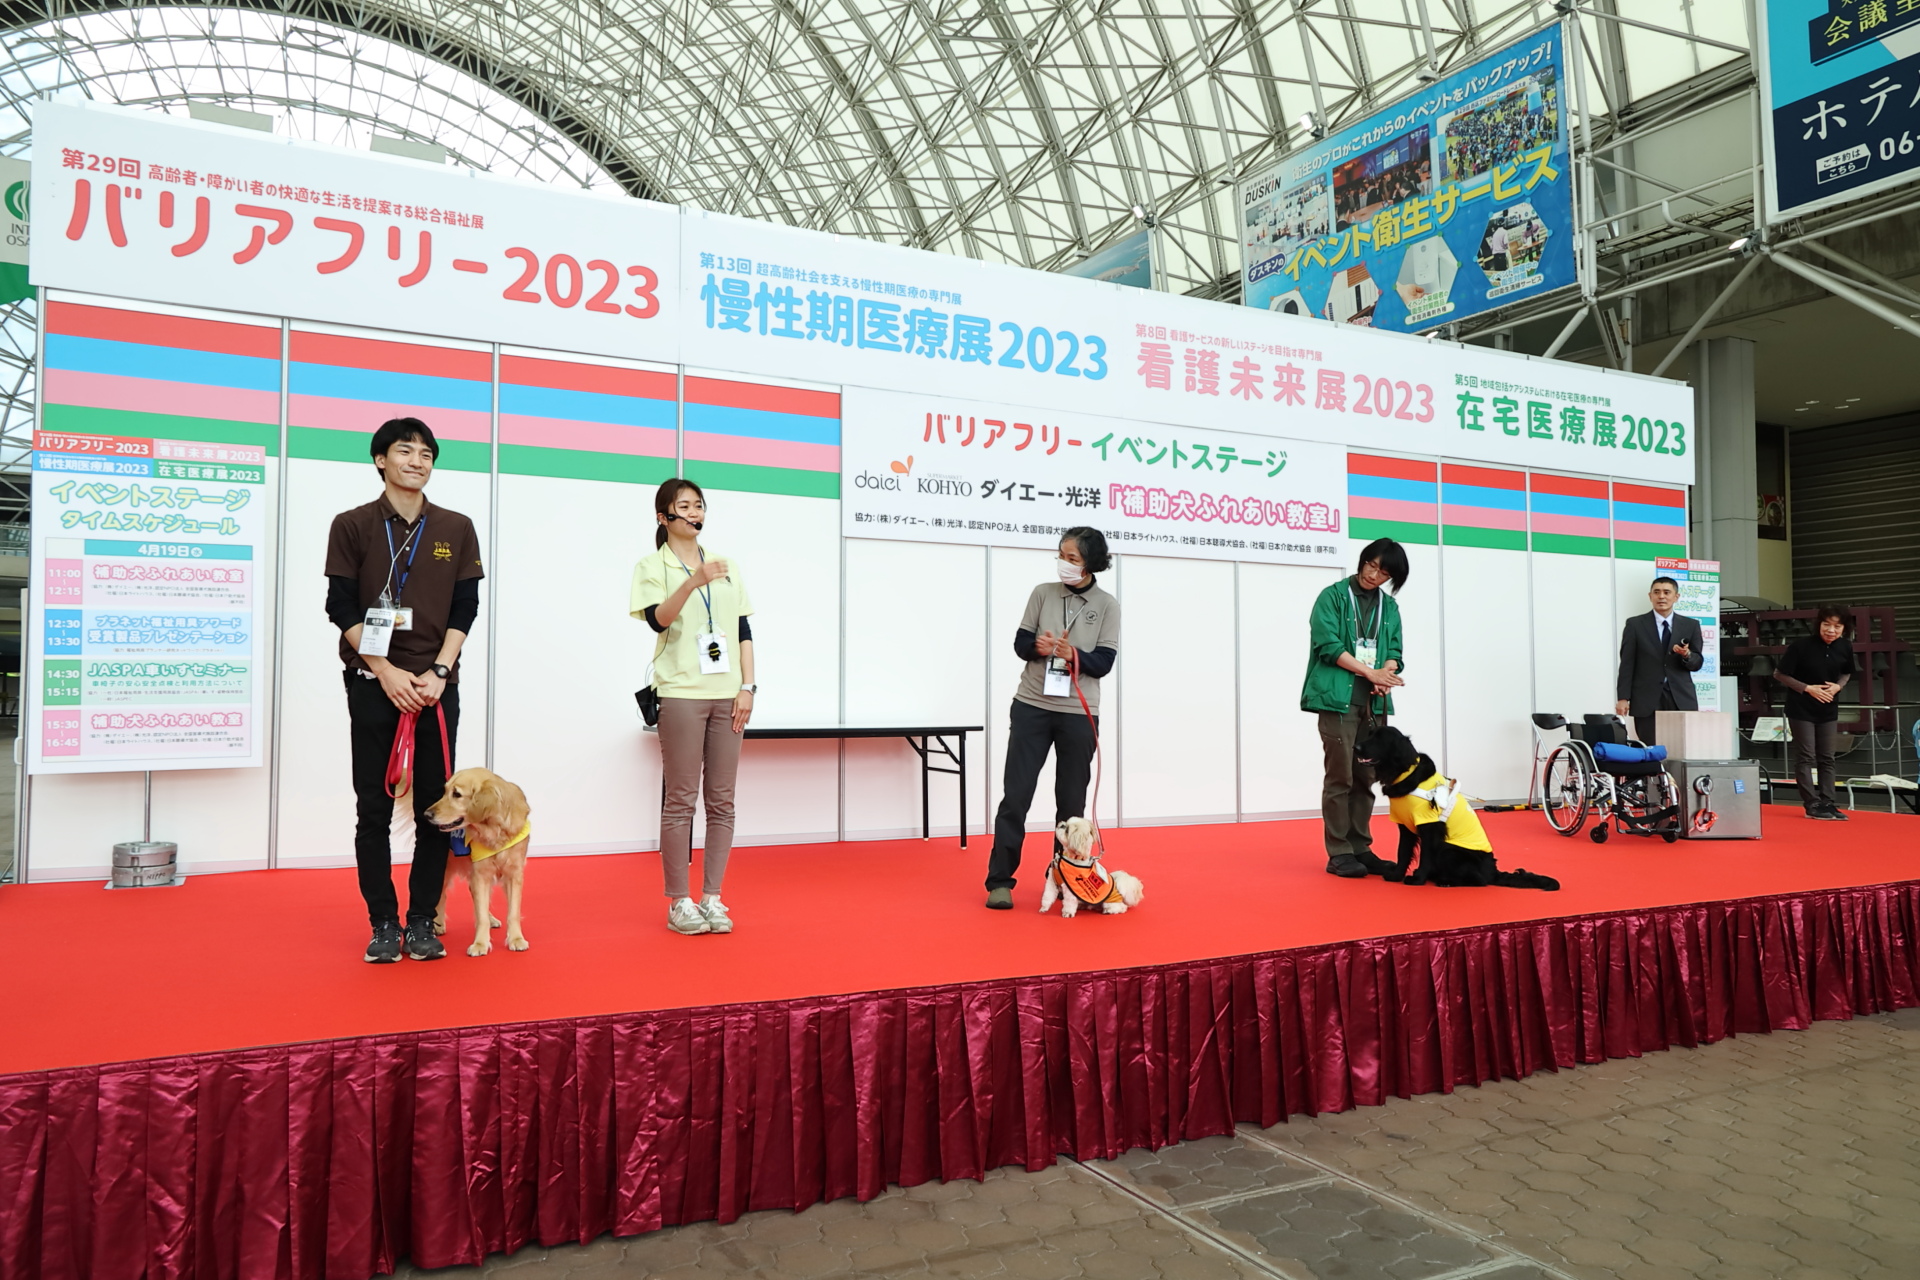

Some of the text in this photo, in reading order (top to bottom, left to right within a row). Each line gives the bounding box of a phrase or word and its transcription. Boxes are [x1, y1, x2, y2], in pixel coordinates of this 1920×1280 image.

[1823, 149, 1861, 168] ご予約は
[1829, 162, 1856, 178] こちら
[62, 148, 485, 230] 第29回 高齢者・障がい者の快適な生活を提案する総合福祉展
[1284, 146, 1559, 281] イベント衛生サービス
[699, 251, 963, 306] 第13回 超高齢社会を支える慢性期医療の専門展
[1250, 258, 1284, 281] ダスキンの
[699, 273, 1109, 381] 慢性期医療展2023
[1135, 323, 1323, 362] 第8回 看護サービスの新しいステージを目指す専門展
[1137, 341, 1435, 424] 看護未来展2023
[1455, 373, 1612, 408] 第5回 地域包括ケアシステムにおける在宅医療の専門展
[1456, 390, 1686, 457] 在宅医療展2023
[38, 436, 150, 455] バリアフリー2023
[158, 445, 261, 463] 看護未来展2023
[38, 457, 150, 476] 慢性期医療展2023
[158, 464, 261, 482] 在宅医療展2023
[854, 469, 902, 492] daiei
[917, 477, 973, 497] KOHYO
[50, 480, 251, 512] イベントステージ
[61, 510, 241, 536] タイムスケジュール
[48, 568, 81, 578] 11:00
[93, 564, 245, 583] 補助犬ふれあい教室
[48, 586, 81, 596] 12:15
[48, 619, 80, 629] 12:30
[47, 637, 80, 647] 13:30
[88, 629, 247, 644] 受賞製品プレゼンテーション
[47, 669, 80, 679] 14:30
[87, 663, 247, 678] JASPA車いすセミナー
[46, 687, 80, 697] 15:15
[46, 720, 79, 730] 15:30
[91, 712, 243, 730] 補助犬ふれあい教室
[45, 738, 79, 747] 16:45
